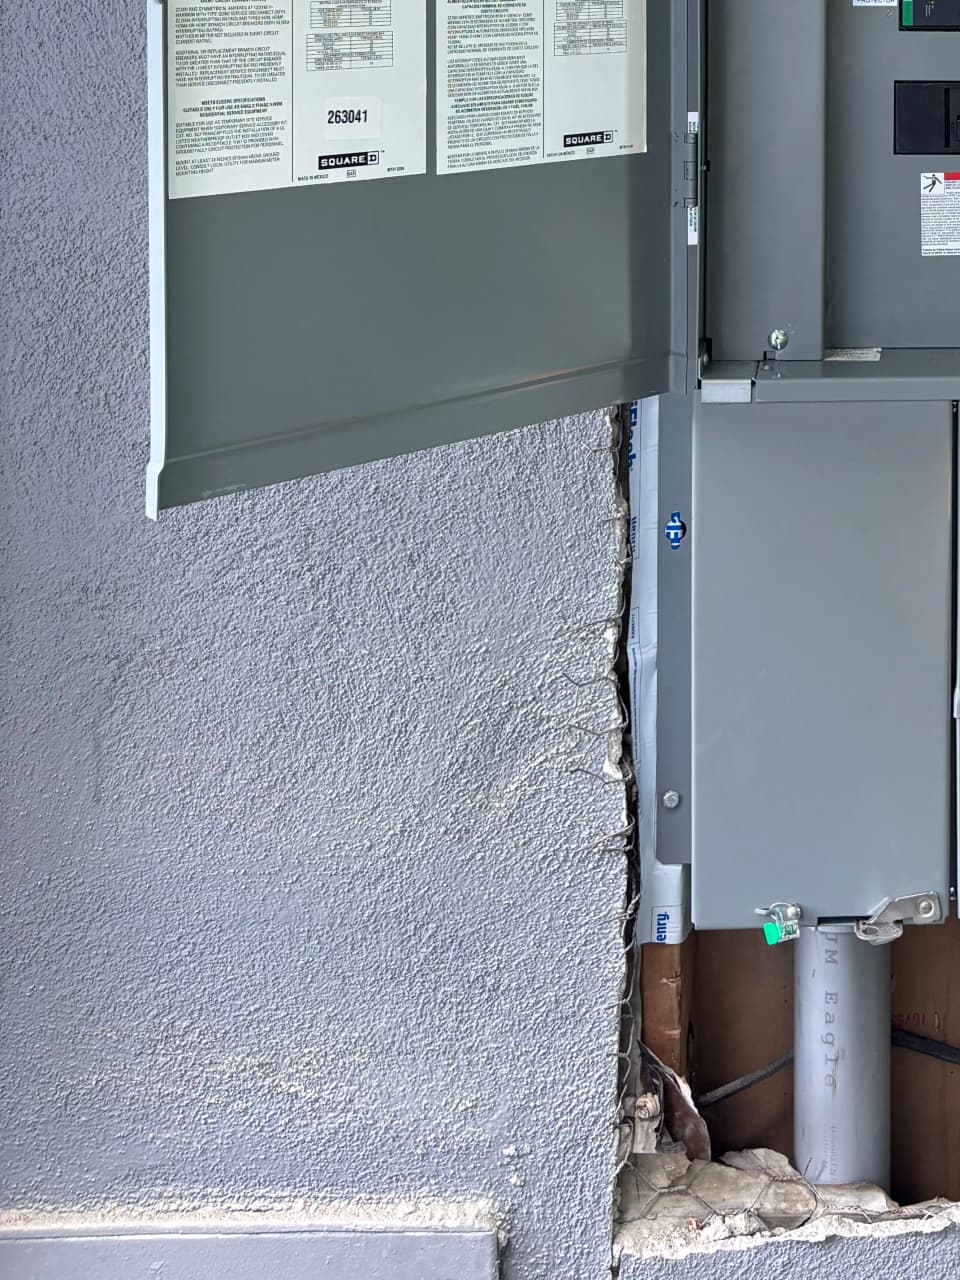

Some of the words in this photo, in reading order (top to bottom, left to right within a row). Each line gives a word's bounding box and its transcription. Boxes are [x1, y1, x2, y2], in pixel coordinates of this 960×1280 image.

[328, 109, 367, 124] 263041
[566, 134, 602, 145] SQUARE
[321, 155, 366, 167] SQUARE
[656, 913, 670, 944] enry
[821, 990, 840, 1089] Eagle
